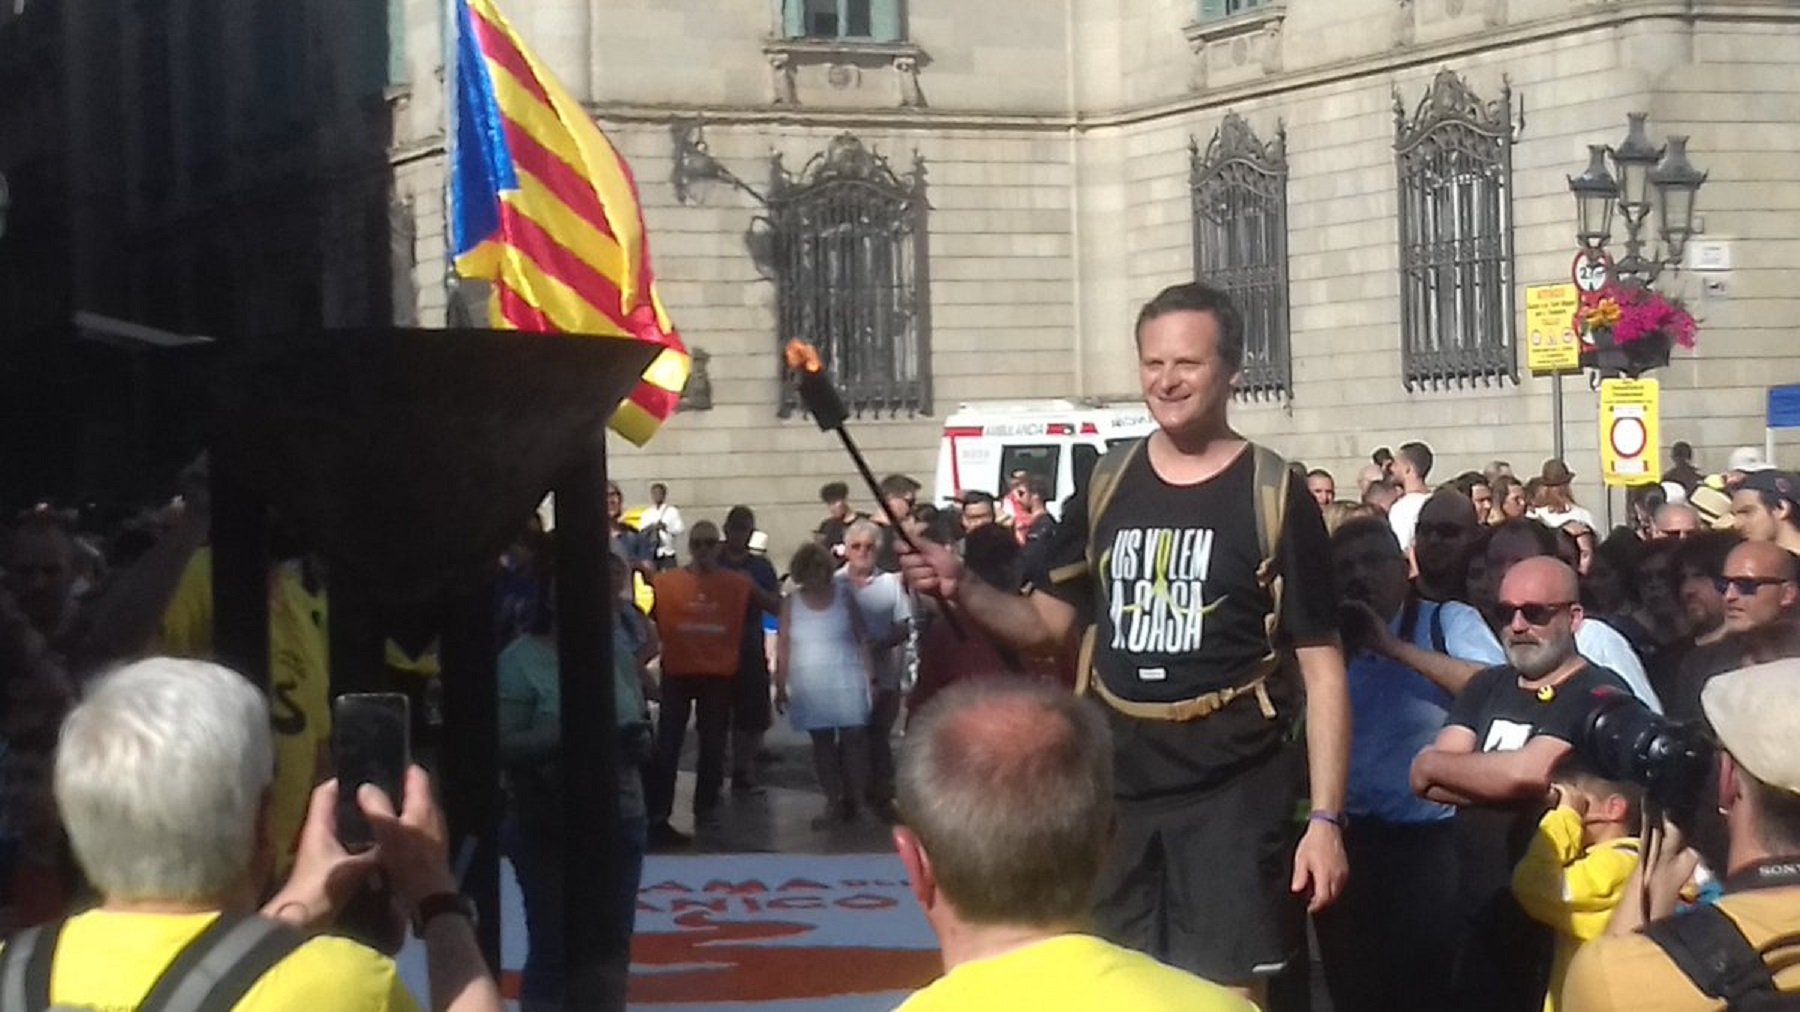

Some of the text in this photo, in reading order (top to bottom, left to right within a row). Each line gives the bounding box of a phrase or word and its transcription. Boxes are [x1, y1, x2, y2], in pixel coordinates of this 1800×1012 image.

[1111, 528, 1214, 581] US VOLEM
[1128, 579, 1204, 653] CASA
